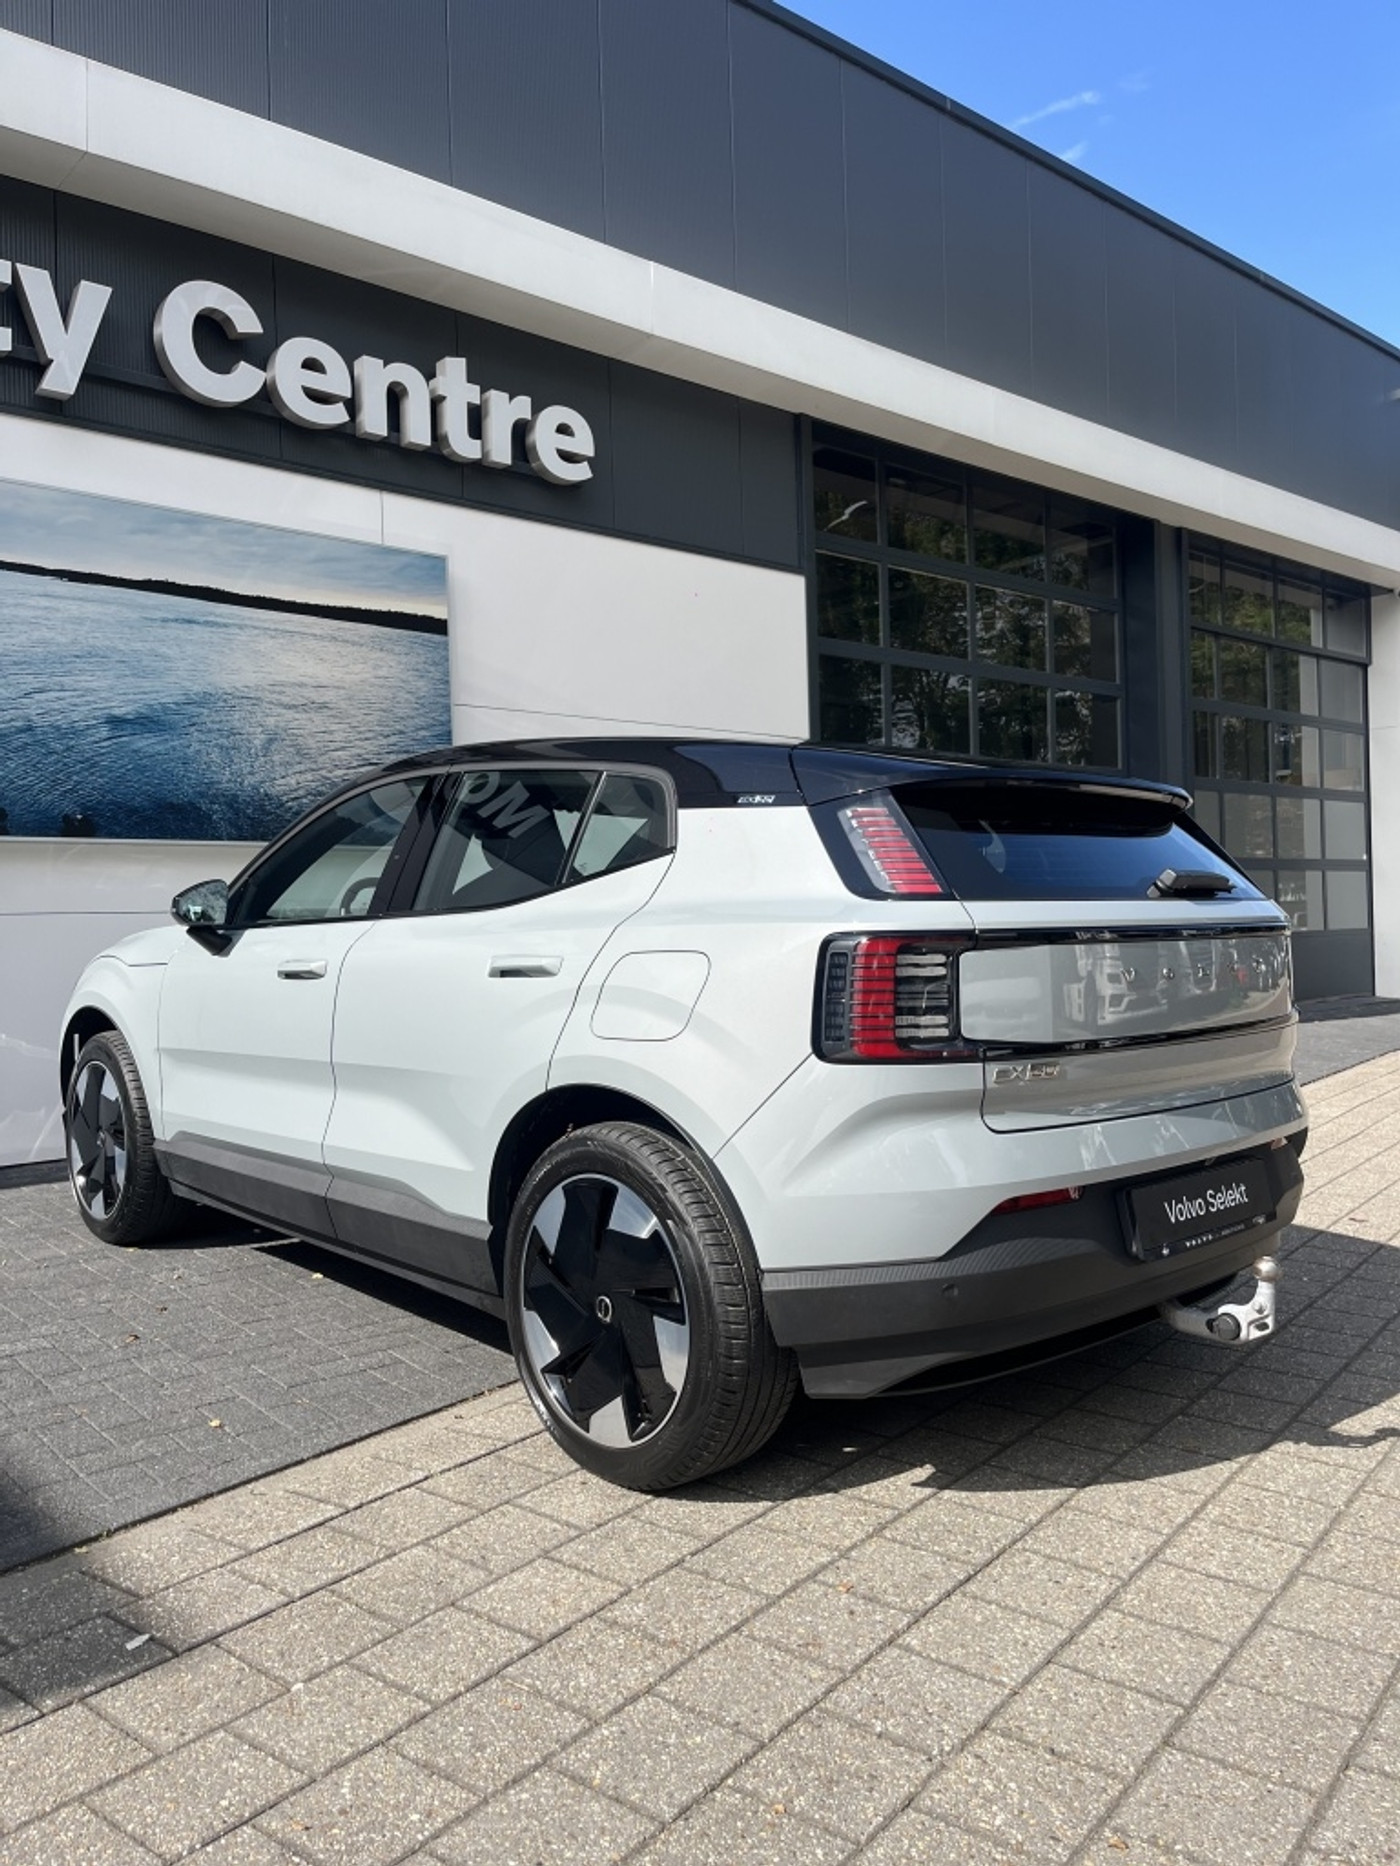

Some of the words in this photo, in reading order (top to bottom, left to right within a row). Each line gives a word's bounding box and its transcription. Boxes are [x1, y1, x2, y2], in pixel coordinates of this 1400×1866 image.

[0, 259, 113, 400] y
[153, 280, 595, 486] Centre
[1163, 1195, 1206, 1224] Volvo
[1206, 1182, 1249, 1213] Selekt
